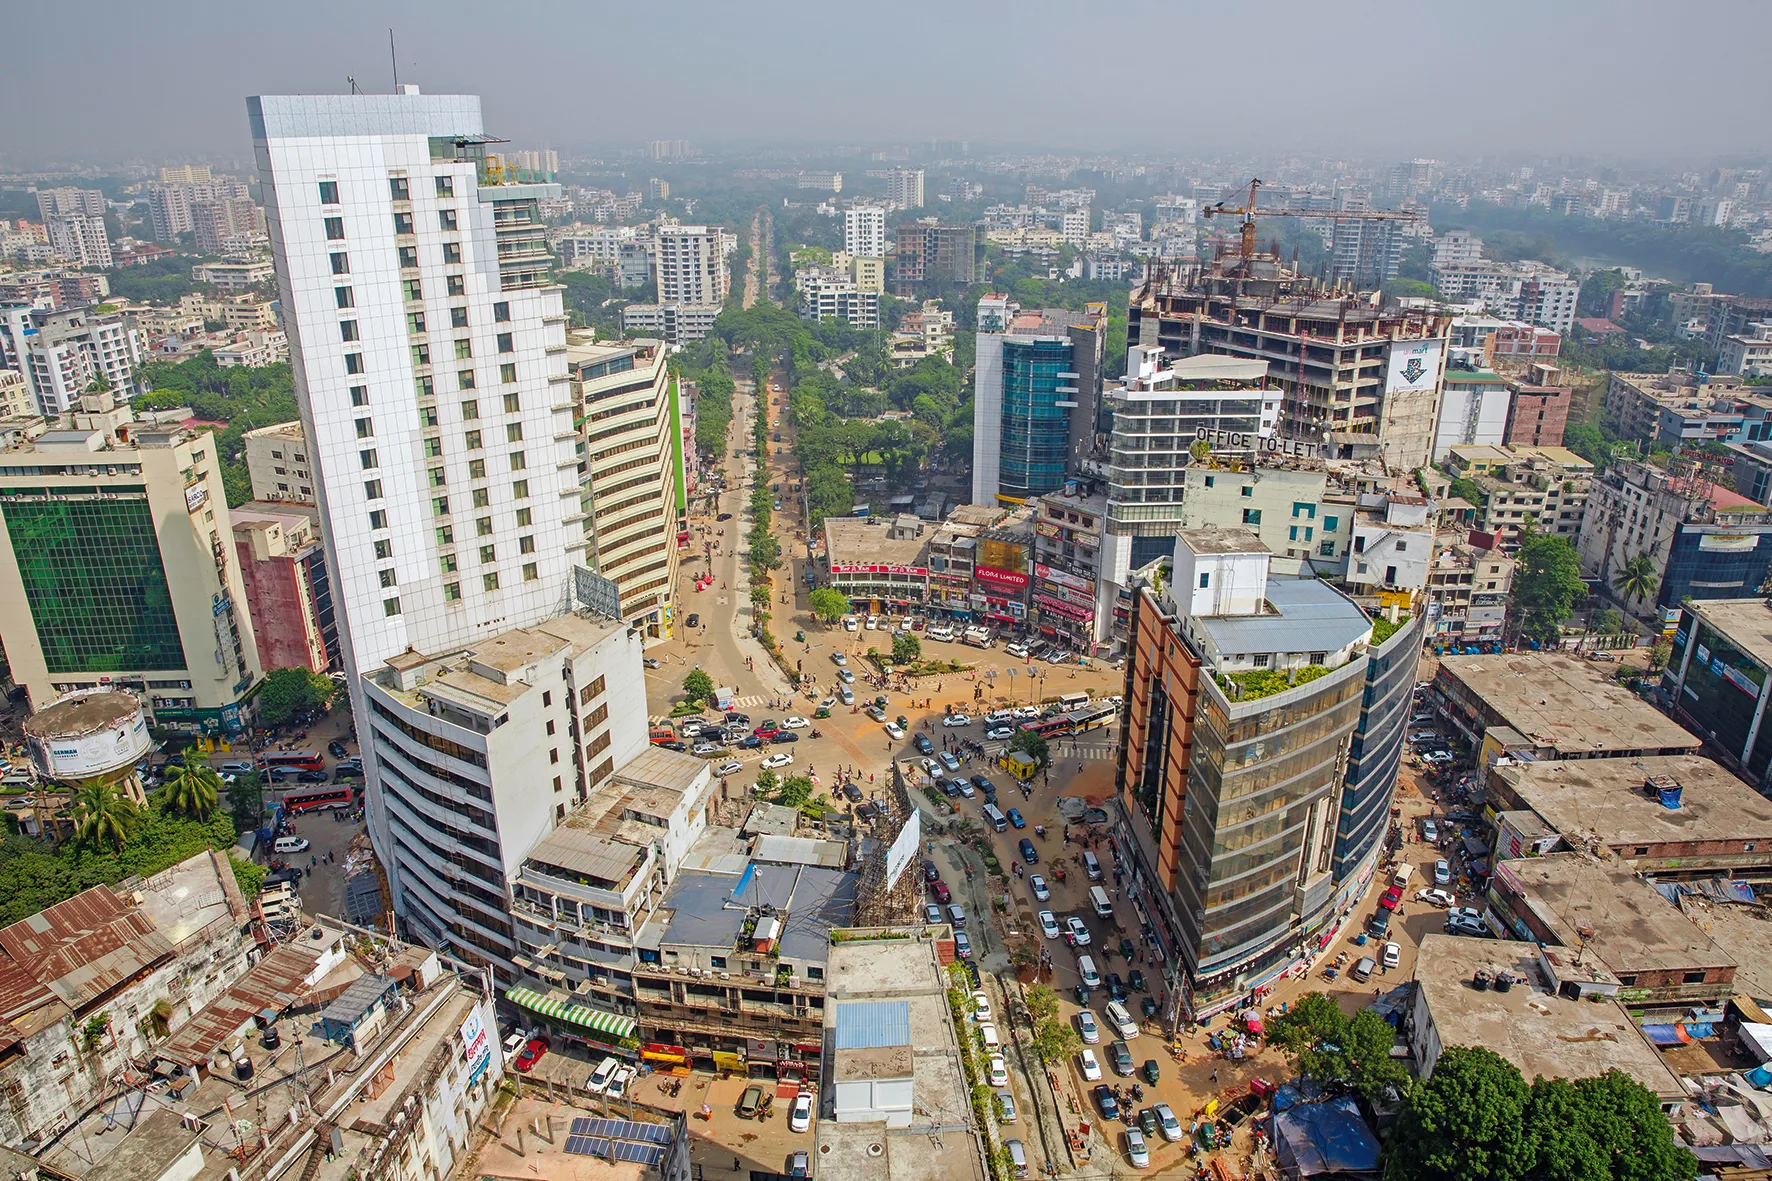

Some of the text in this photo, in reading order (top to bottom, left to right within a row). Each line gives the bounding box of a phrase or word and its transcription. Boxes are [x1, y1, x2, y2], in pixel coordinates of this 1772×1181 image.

[1196, 427, 1316, 458] OFFICE TO-LET
[978, 569, 1025, 583] FLORA LIMITED
[625, 592, 656, 606] LANDMARK
